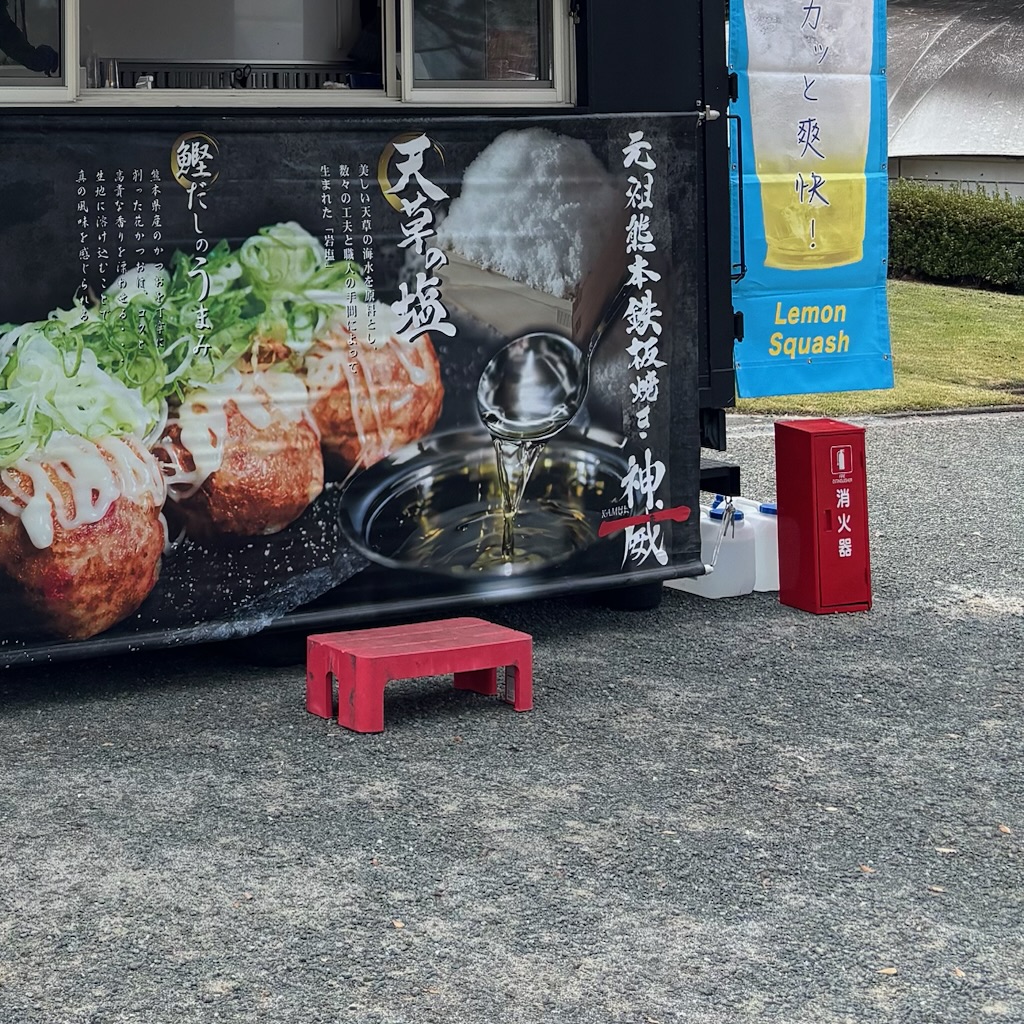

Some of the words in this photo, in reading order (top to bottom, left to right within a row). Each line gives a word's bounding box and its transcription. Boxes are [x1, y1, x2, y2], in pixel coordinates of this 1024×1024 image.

[76, 169, 91, 322] 真の風味を感じられる
[95, 169, 110, 321] 生地に溶け込むことで
[176, 140, 214, 357] 鰹だしのうまみ
[320, 164, 336, 269] 生まれた「岩塩」
[339, 164, 358, 375] 数々の工夫と職人の手間によって
[384, 133, 457, 344] 天草の塩
[622, 130, 668, 440] 元祖熊本鉄板焼き
[768, 331, 849, 359] Squash
[775, 301, 846, 325] Lemon
[619, 448, 669, 570] 神威
[836, 488, 853, 558] 消火器
